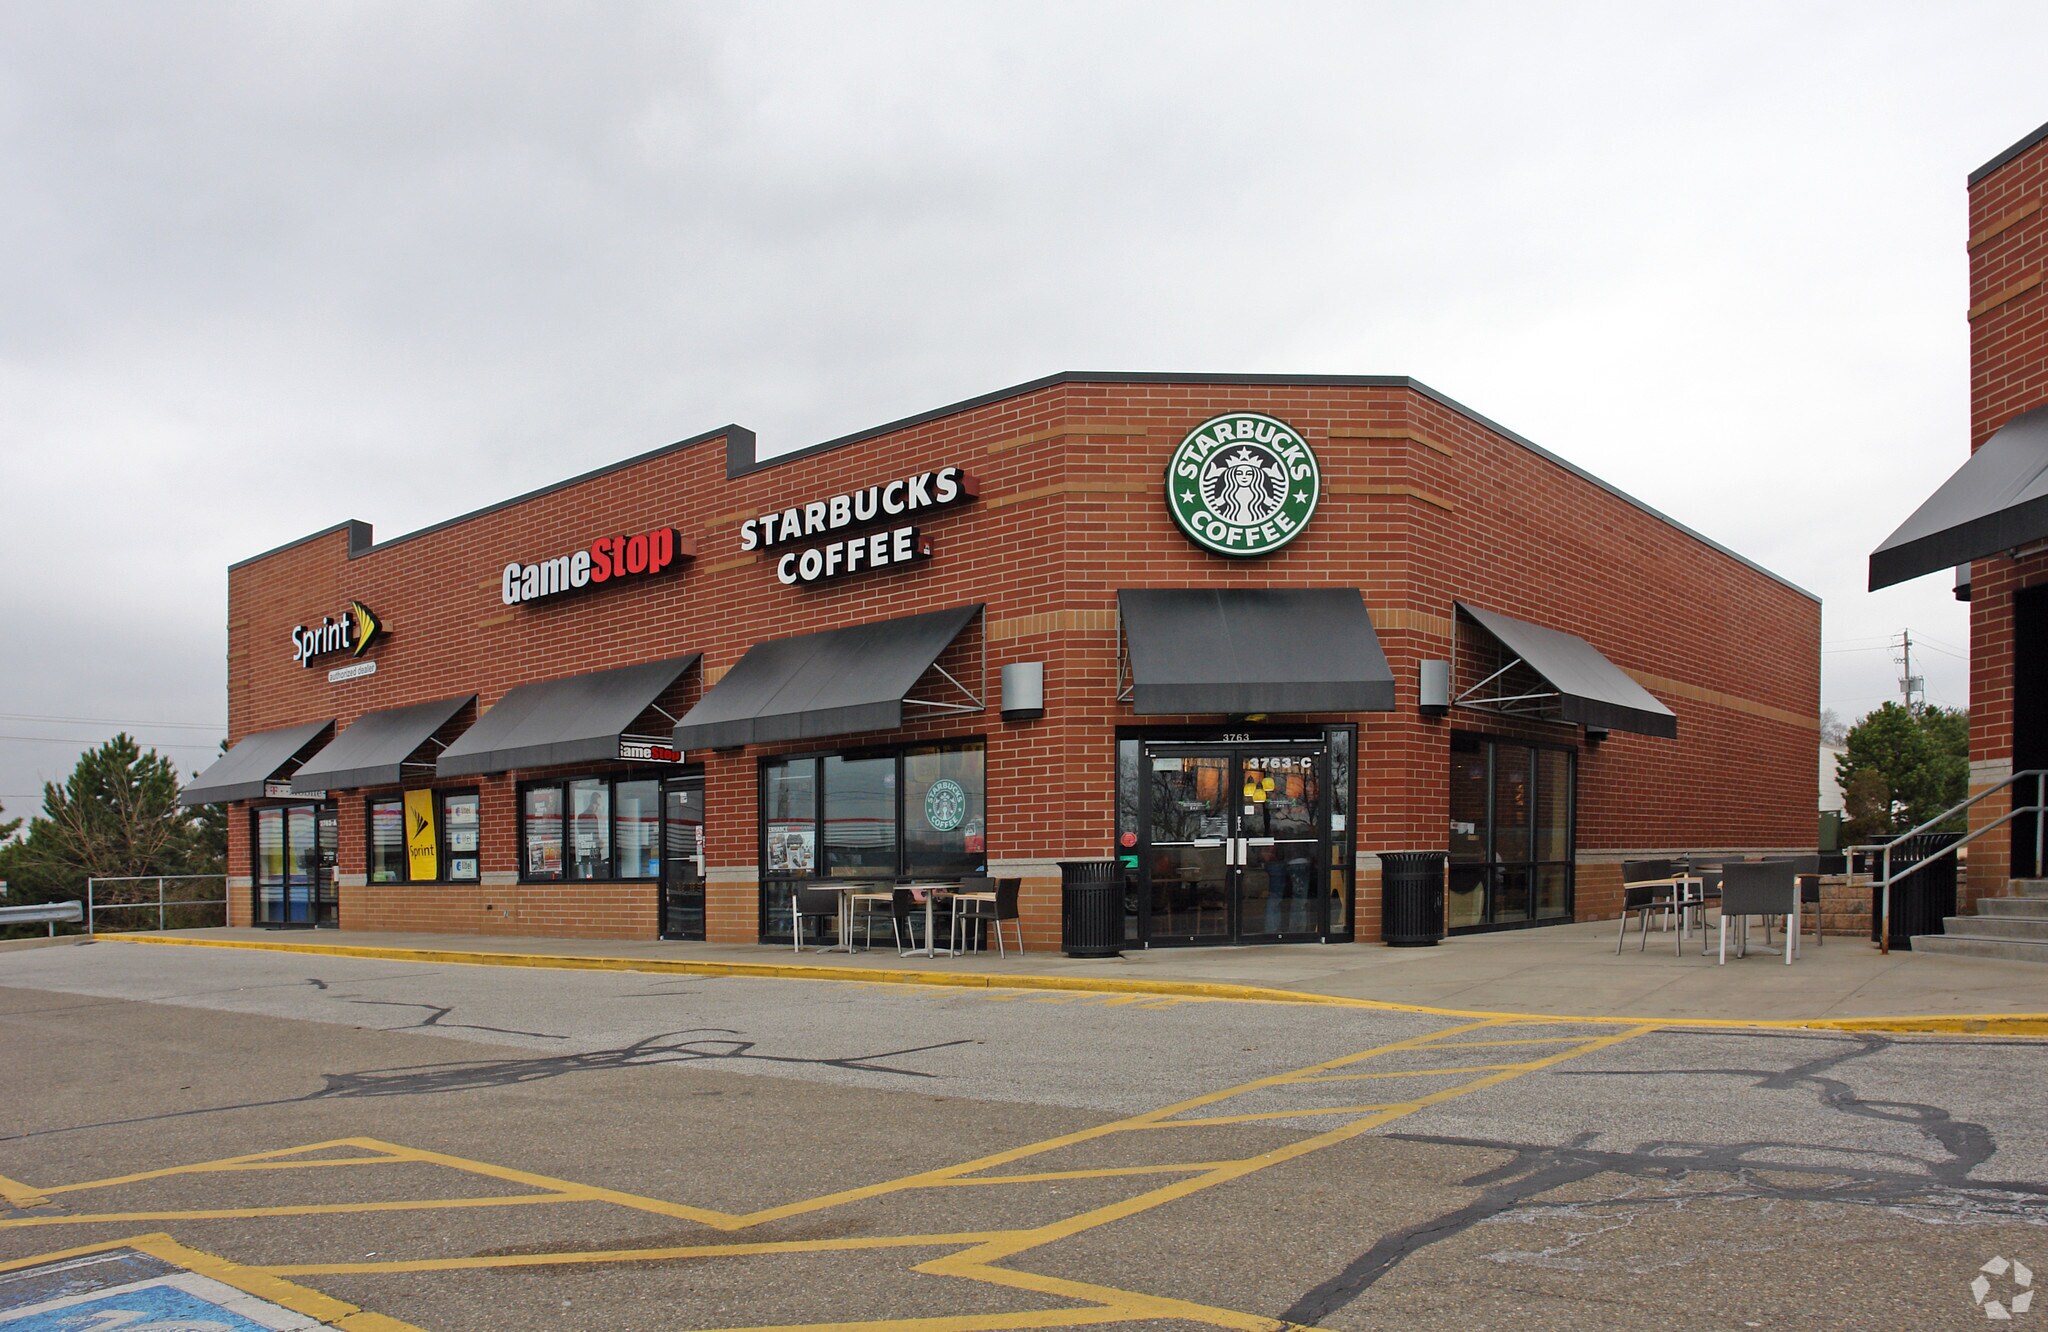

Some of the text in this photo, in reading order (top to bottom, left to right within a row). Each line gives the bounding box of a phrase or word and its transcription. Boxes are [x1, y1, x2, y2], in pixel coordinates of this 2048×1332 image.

[1177, 420, 1311, 481] STARBUCKS
[740, 467, 958, 551] STARBUCKS
[1191, 511, 1296, 547] COFFEE
[502, 527, 673, 605] GameStop
[777, 526, 913, 585] COFFEE
[292, 612, 350, 668] Sprint
[329, 667, 357, 681] authorized
[1222, 733, 1250, 742] 3763
[1250, 757, 1312, 769] 3763-C
[928, 781, 963, 803] STARBUCKS
[931, 815, 958, 829] COFFEE
[409, 844, 435, 860] Sprint
